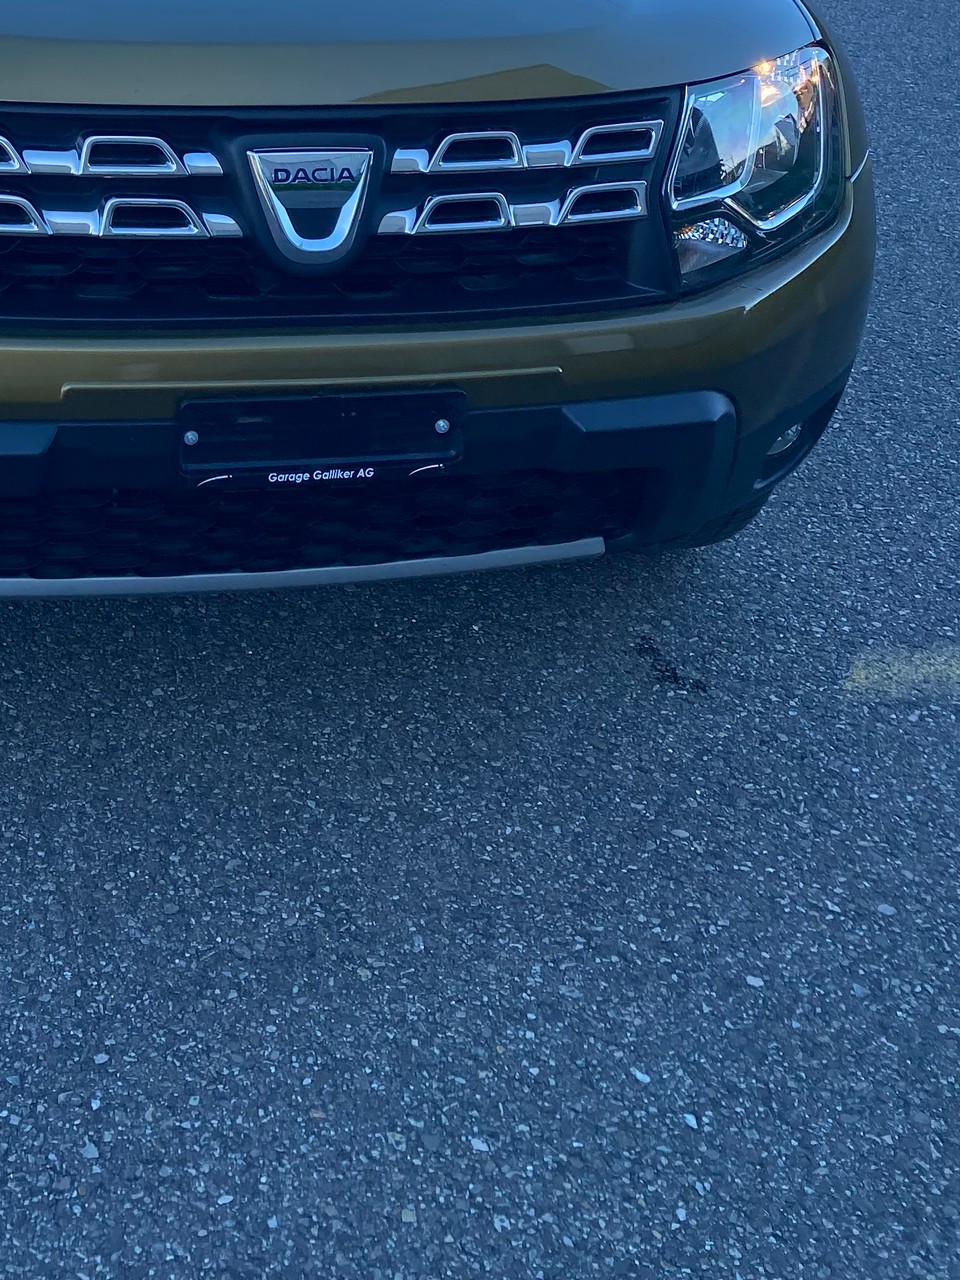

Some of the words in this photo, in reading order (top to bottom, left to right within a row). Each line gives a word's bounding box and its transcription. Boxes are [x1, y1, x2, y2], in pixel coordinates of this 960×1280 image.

[272, 167, 356, 184] DACIA
[268, 472, 310, 483] Garage
[313, 469, 355, 480] Galliker
[357, 467, 375, 478] AG
